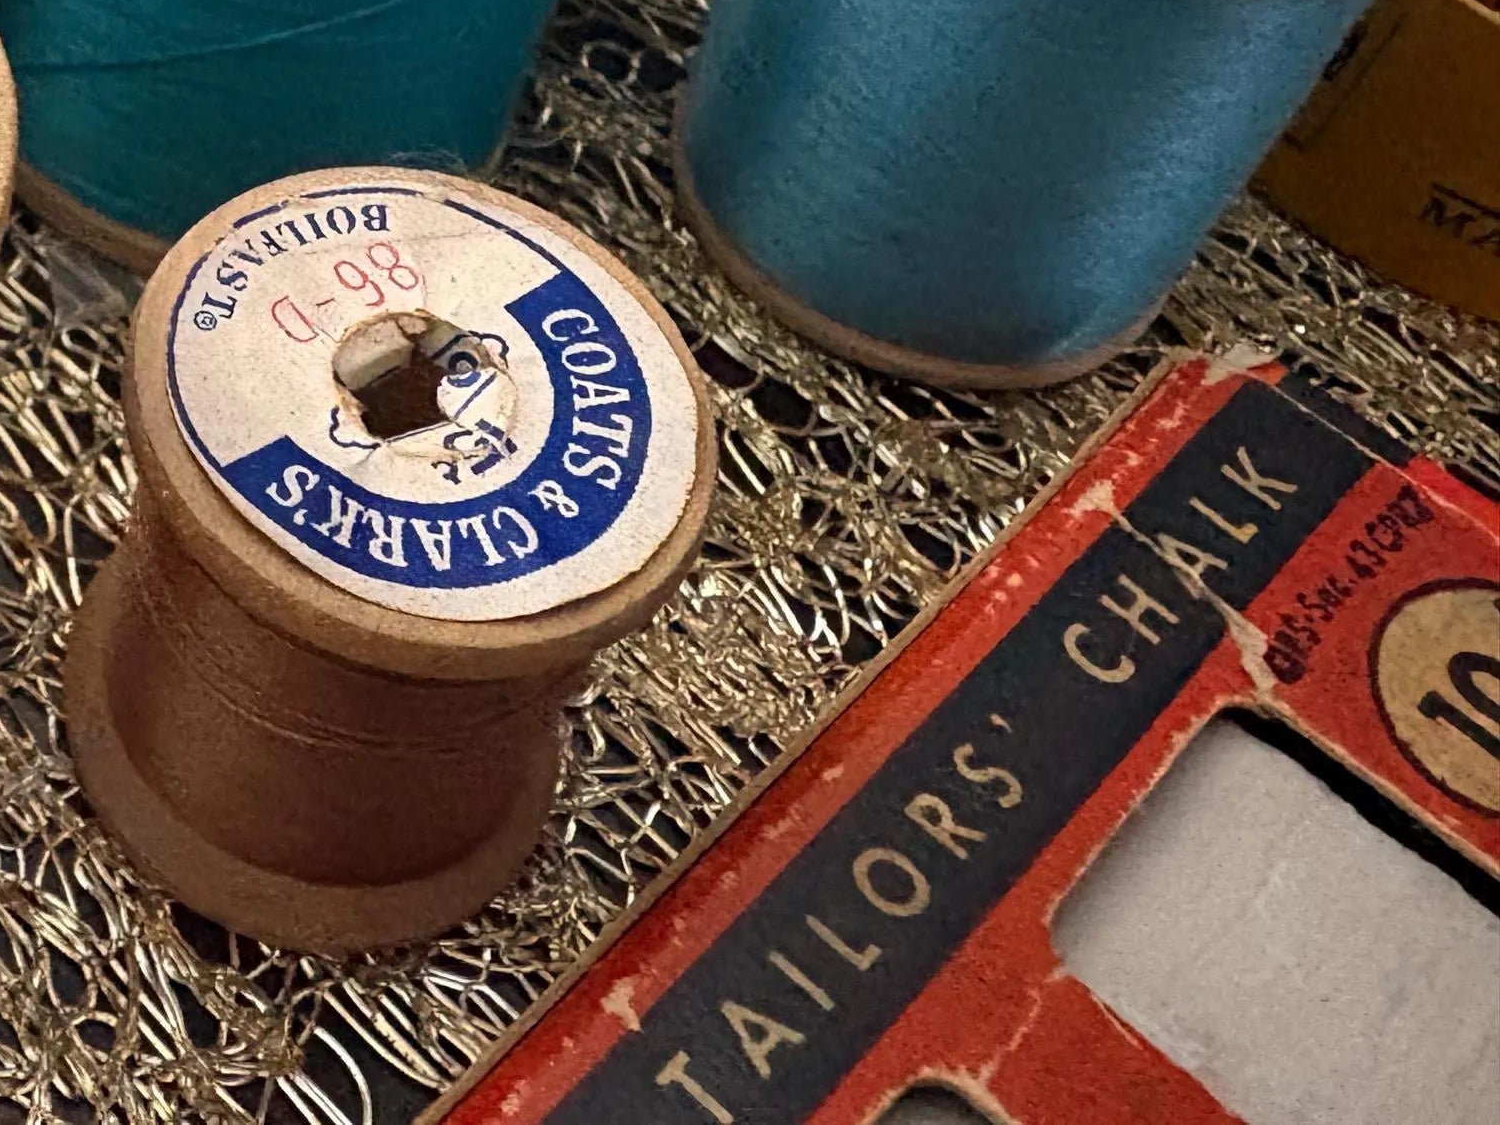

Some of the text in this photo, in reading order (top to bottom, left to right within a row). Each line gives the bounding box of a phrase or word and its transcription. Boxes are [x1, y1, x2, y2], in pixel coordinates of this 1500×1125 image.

[540, 308, 631, 490] COATS
[264, 464, 540, 573] CLARK'S
[529, 478, 580, 520] &
[654, 444, 1299, 1124] TAILORS' CHALK
